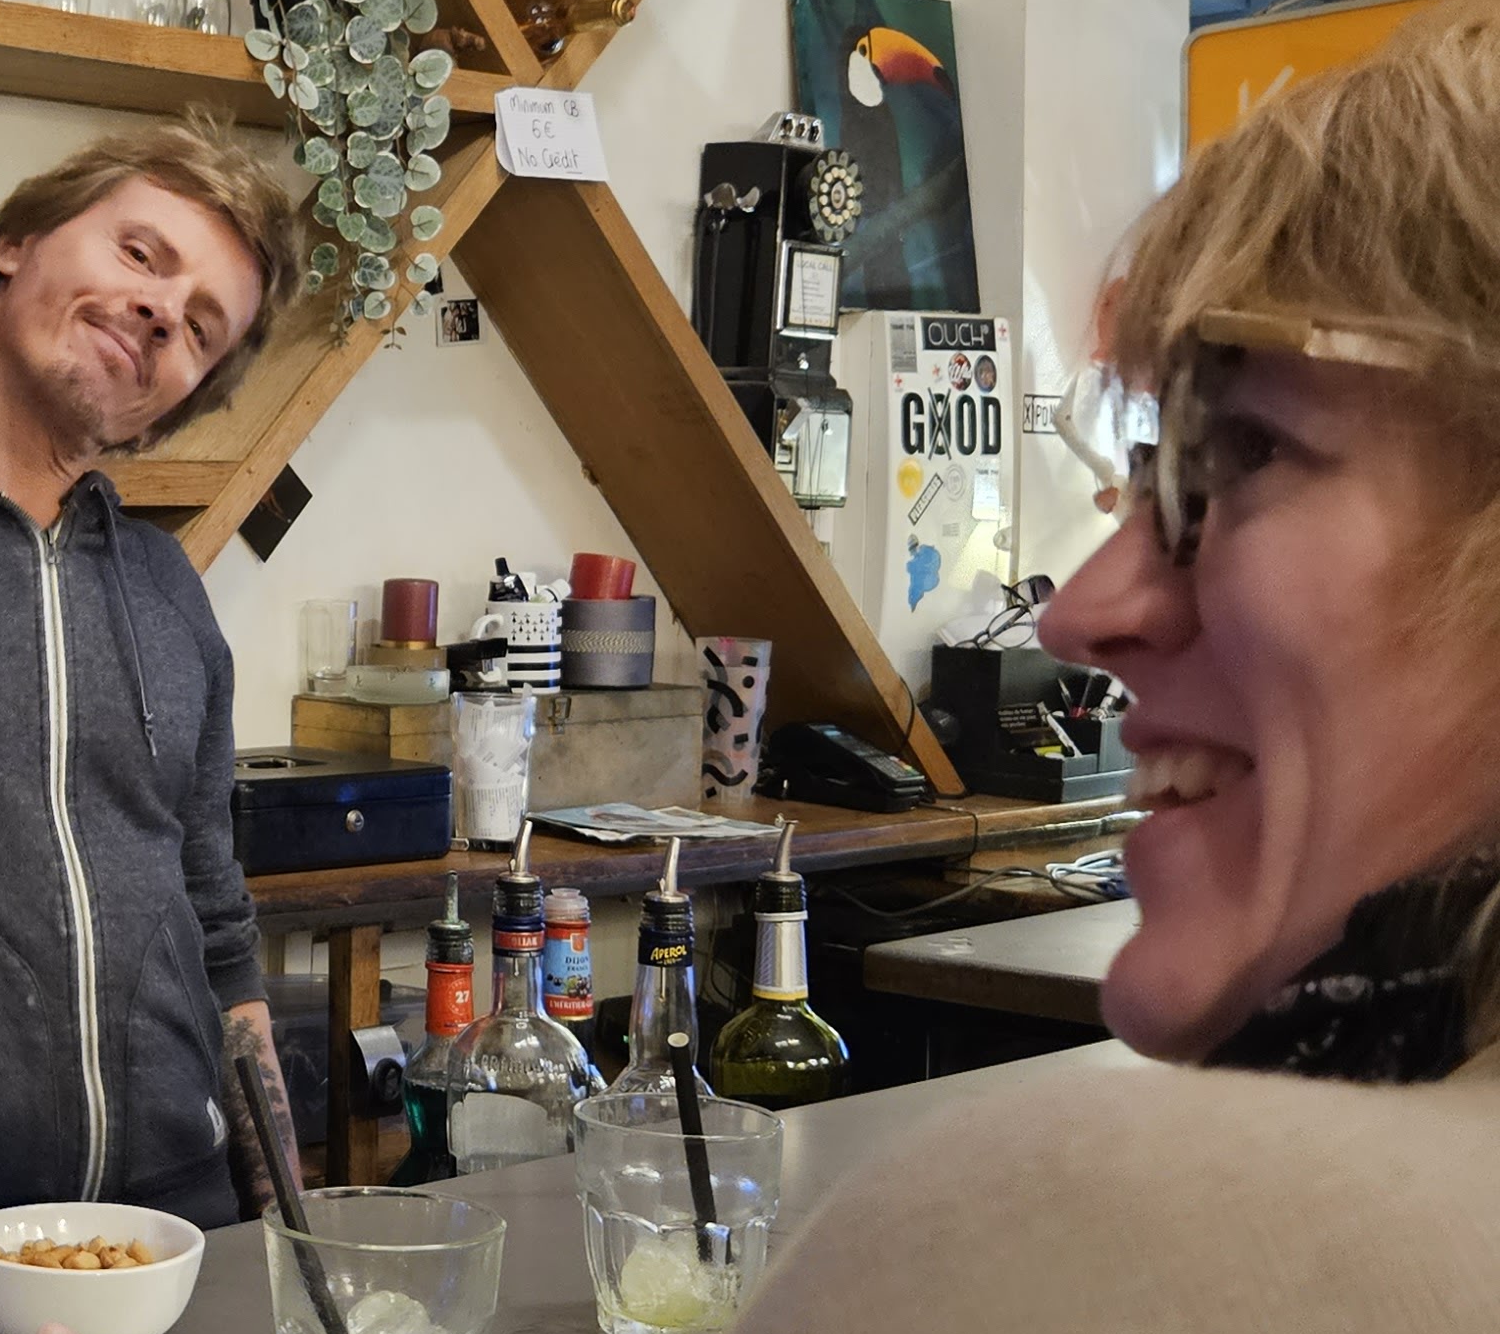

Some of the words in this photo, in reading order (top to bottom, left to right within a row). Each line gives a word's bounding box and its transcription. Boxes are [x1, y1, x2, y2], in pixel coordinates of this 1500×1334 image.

[563, 99, 580, 118] CB
[517, 147, 538, 168] No
[650, 944, 687, 961] APEROL
[455, 990, 470, 1003] 27
